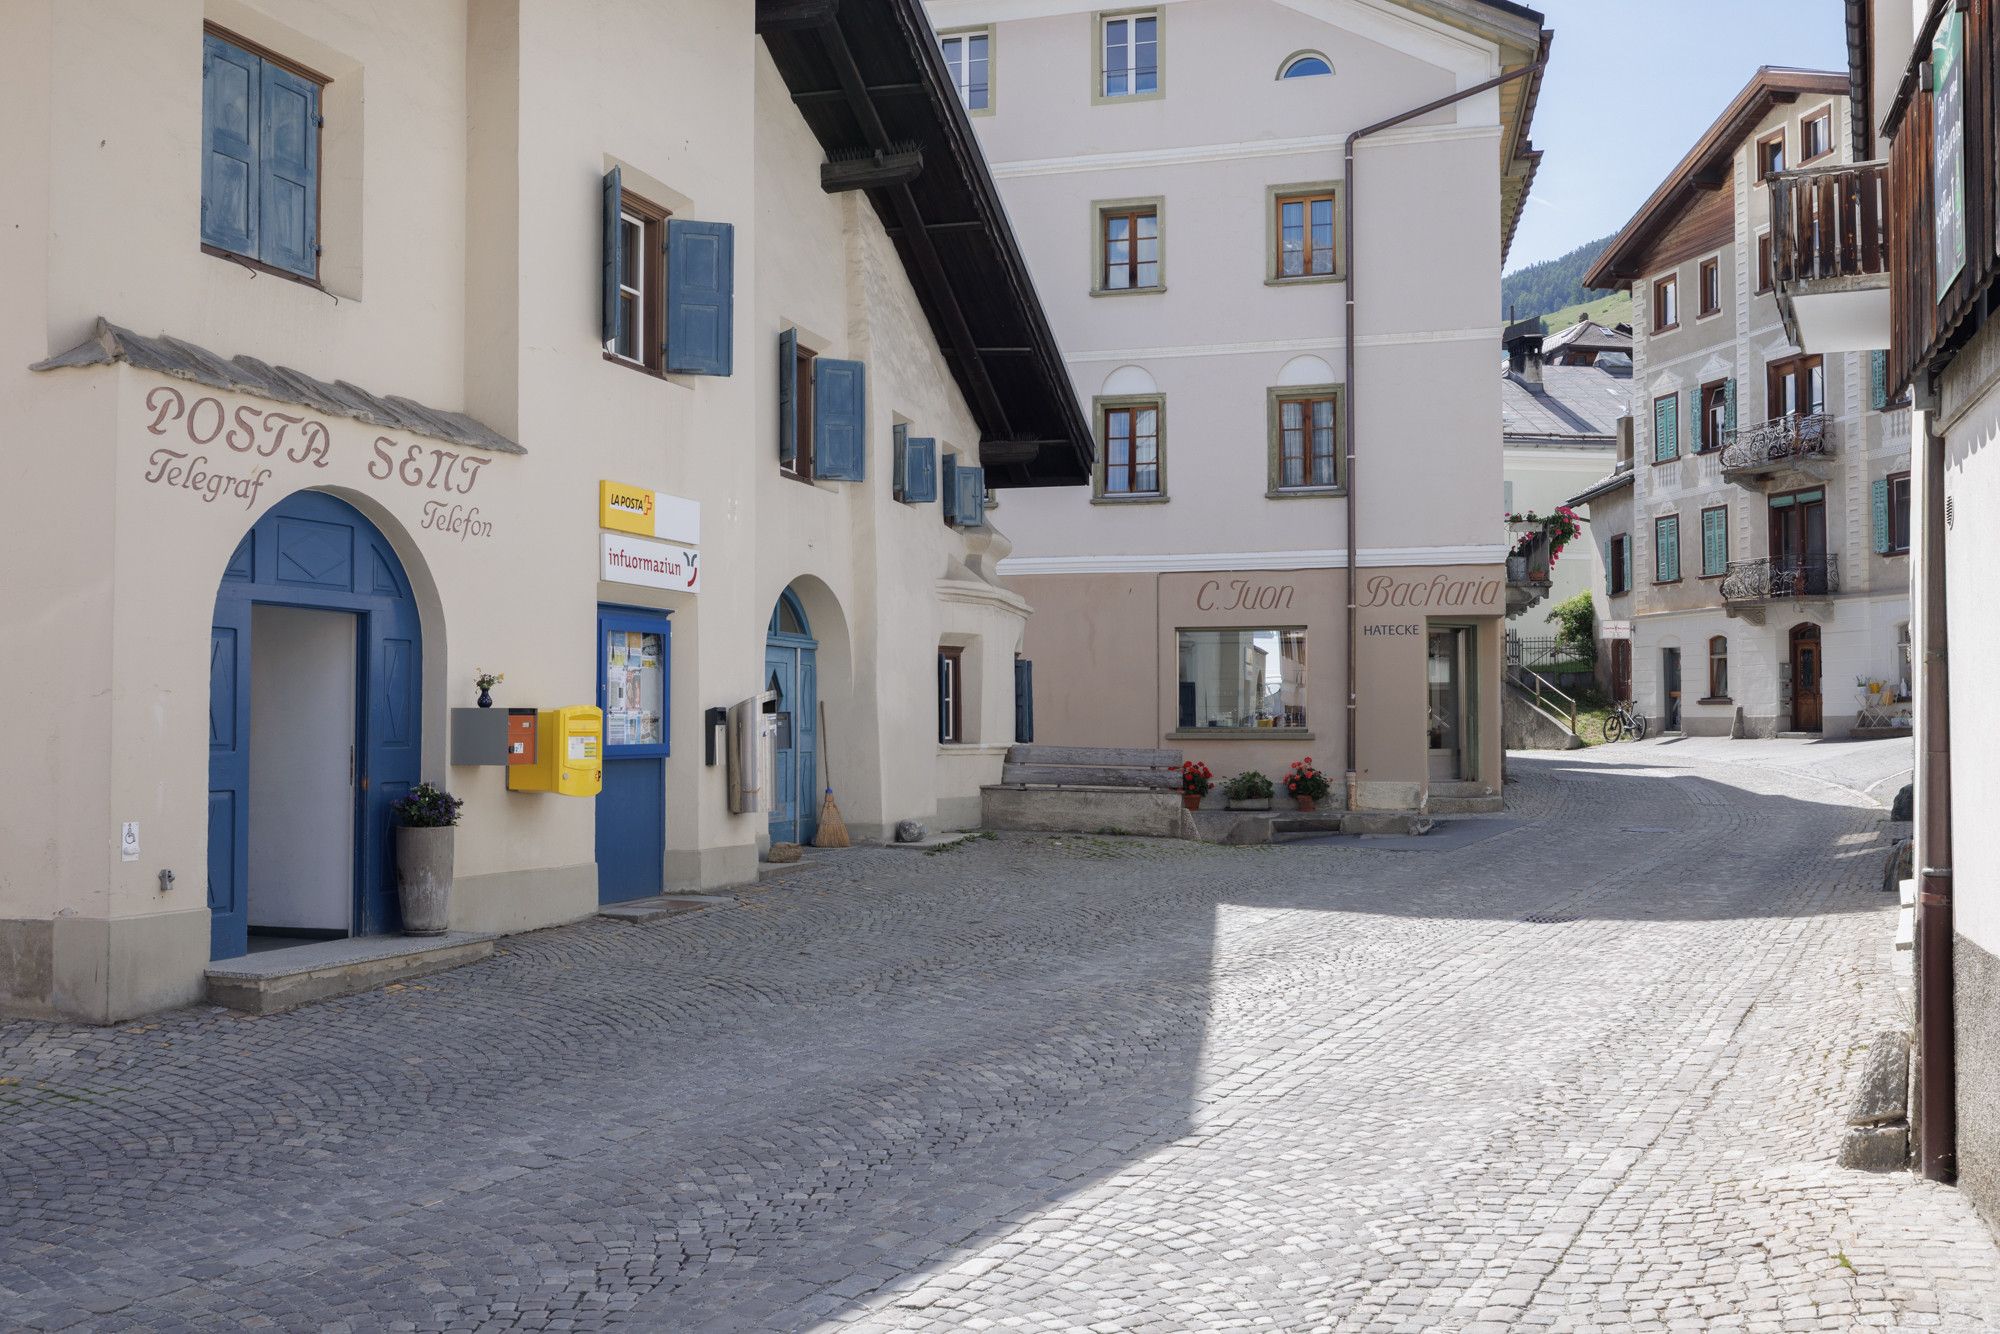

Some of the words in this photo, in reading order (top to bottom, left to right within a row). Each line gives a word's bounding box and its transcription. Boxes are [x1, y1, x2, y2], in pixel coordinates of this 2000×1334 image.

[146, 386, 331, 468] POSTA
[367, 436, 492, 494] SENT
[145, 448, 272, 511] Telegraf
[611, 494, 619, 506] LA
[621, 496, 643, 511] POSTA
[420, 500, 493, 542] Telefon
[608, 548, 681, 576] infuormaziun
[1359, 574, 1501, 608] Bacharia
[1363, 624, 1420, 637] HATECKE
